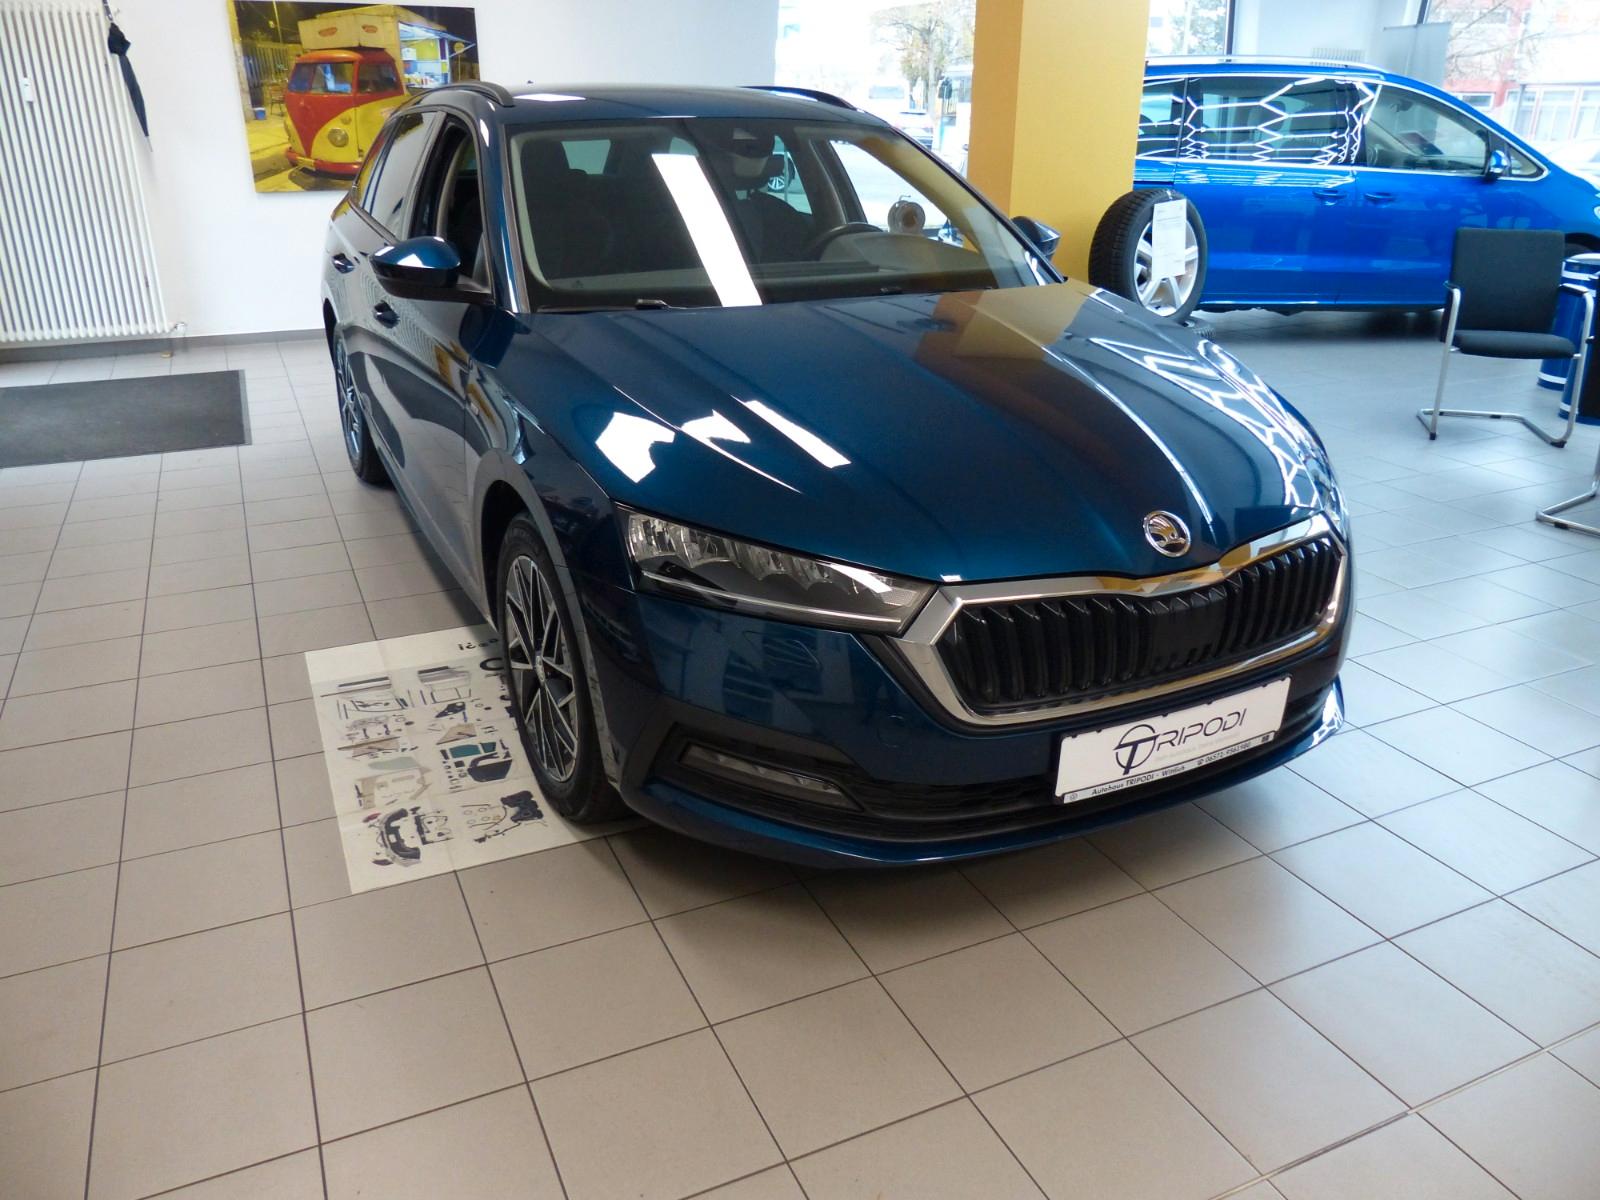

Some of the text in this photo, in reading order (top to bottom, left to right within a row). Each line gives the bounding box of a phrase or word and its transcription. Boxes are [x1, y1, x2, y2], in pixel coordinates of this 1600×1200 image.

[1112, 708, 1247, 776] TRIPODI
[1091, 783, 1124, 796] Autohaus
[1126, 773, 1155, 786] TRIPODI
